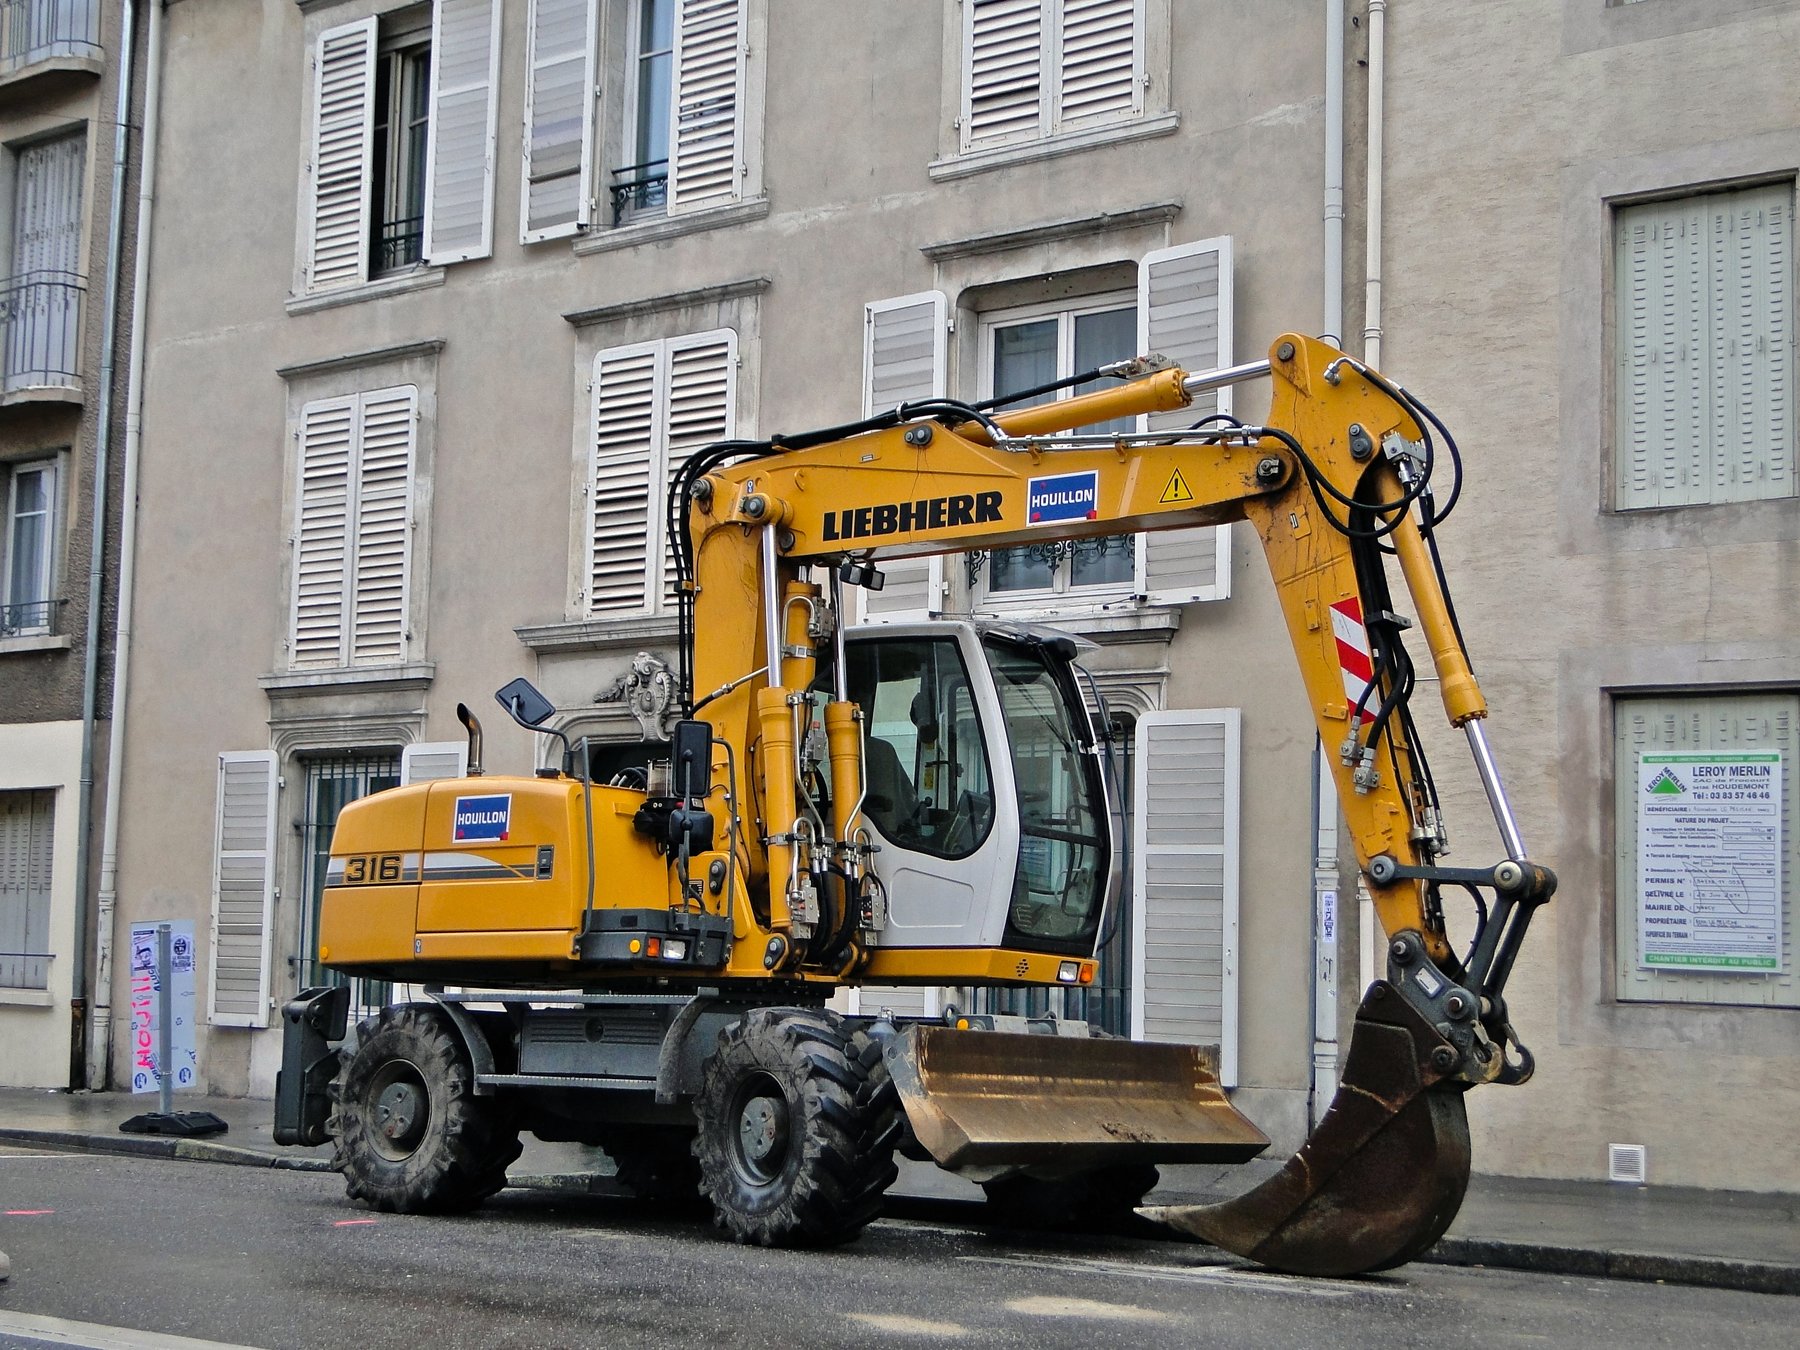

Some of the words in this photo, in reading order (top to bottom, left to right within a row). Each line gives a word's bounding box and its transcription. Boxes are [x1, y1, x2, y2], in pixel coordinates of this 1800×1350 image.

[1032, 488, 1093, 509] HOUILLON
[823, 490, 1003, 542] LIEBHERR
[1662, 766, 1688, 794] MERLIN
[1692, 766, 1726, 777] LEROY
[1729, 766, 1771, 777] MERLIN
[1644, 772, 1666, 794] LEROY
[1710, 792, 1721, 800] 03
[1722, 792, 1733, 800] 83
[1735, 792, 1745, 800] 57
[458, 810, 507, 826] HOUILLON
[347, 855, 400, 883] 316
[1649, 955, 1687, 963] CHANTIER
[1689, 957, 1725, 965] INTERDIT
[1742, 958, 1772, 966] PUBLIC
